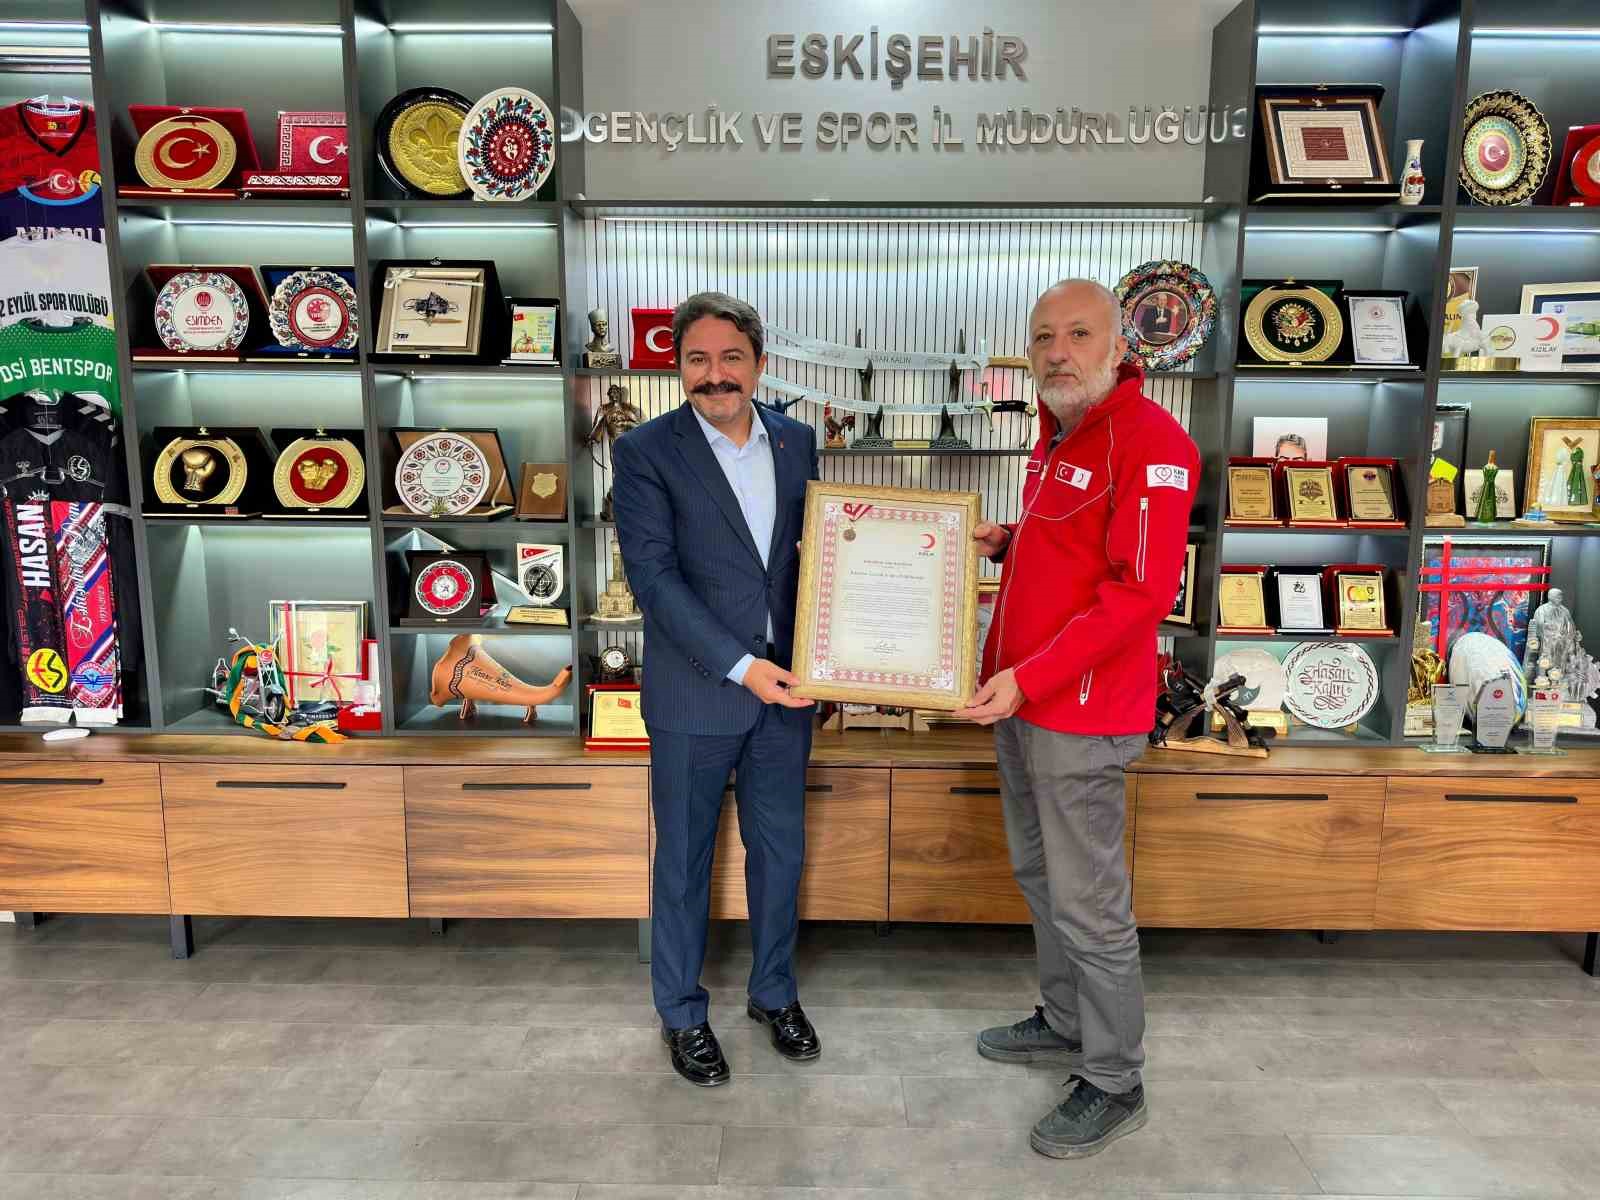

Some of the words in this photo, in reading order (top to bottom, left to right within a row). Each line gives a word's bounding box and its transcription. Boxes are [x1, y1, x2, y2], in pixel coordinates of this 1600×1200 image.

[766, 26, 1028, 90] ESKİŞEHİR
[582, 102, 743, 151] GENÇLİK
[752, 111, 803, 144] VE
[816, 111, 919, 144] SPOR
[929, 104, 964, 145] İL
[8, 292, 38, 316] EYLÜL
[38, 293, 68, 311] SPOR
[68, 293, 108, 317] KULÜBÜ
[30, 358, 113, 384] BENTSPOR
[16, 505, 51, 587] HASAN
